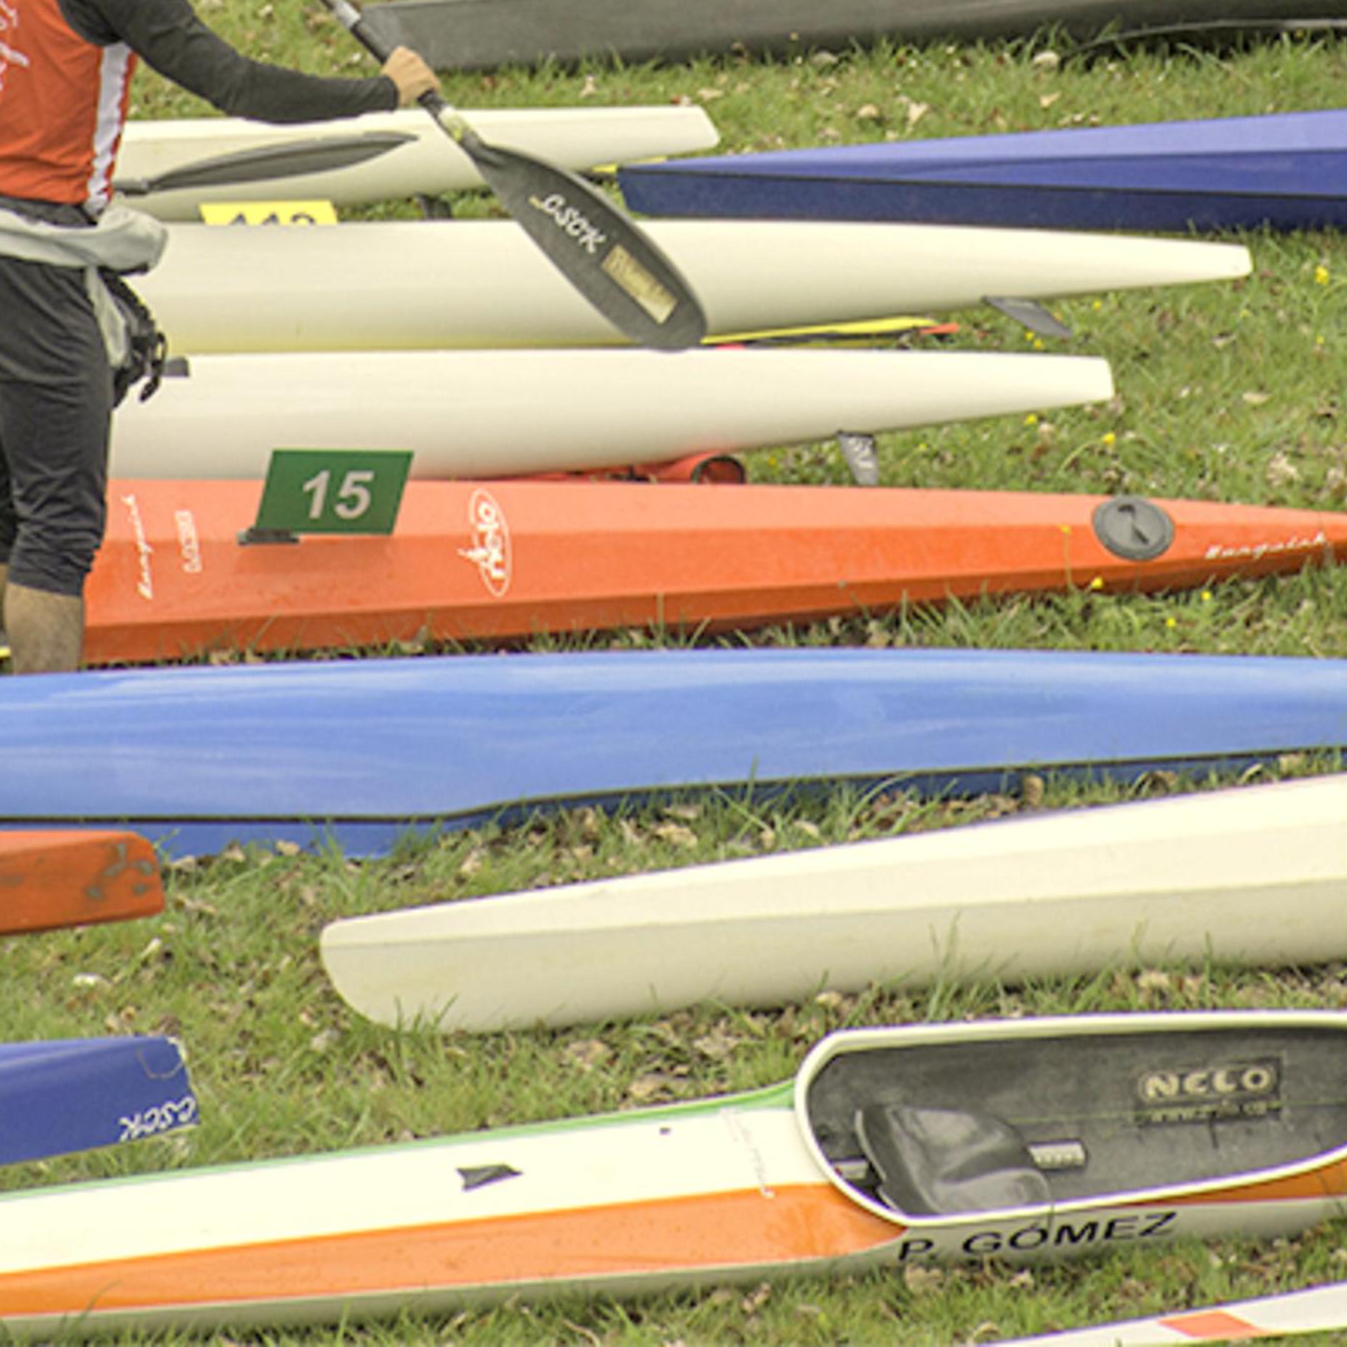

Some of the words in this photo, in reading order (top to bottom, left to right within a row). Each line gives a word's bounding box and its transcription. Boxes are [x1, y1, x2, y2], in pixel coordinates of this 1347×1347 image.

[542, 193, 607, 254] CSCK
[301, 469, 376, 520] 15
[1145, 1068, 1271, 1100] NELO
[118, 1096, 197, 1143] CSCK
[898, 1237, 938, 1261] P.
[962, 1210, 1178, 1255] GÓMEZ
